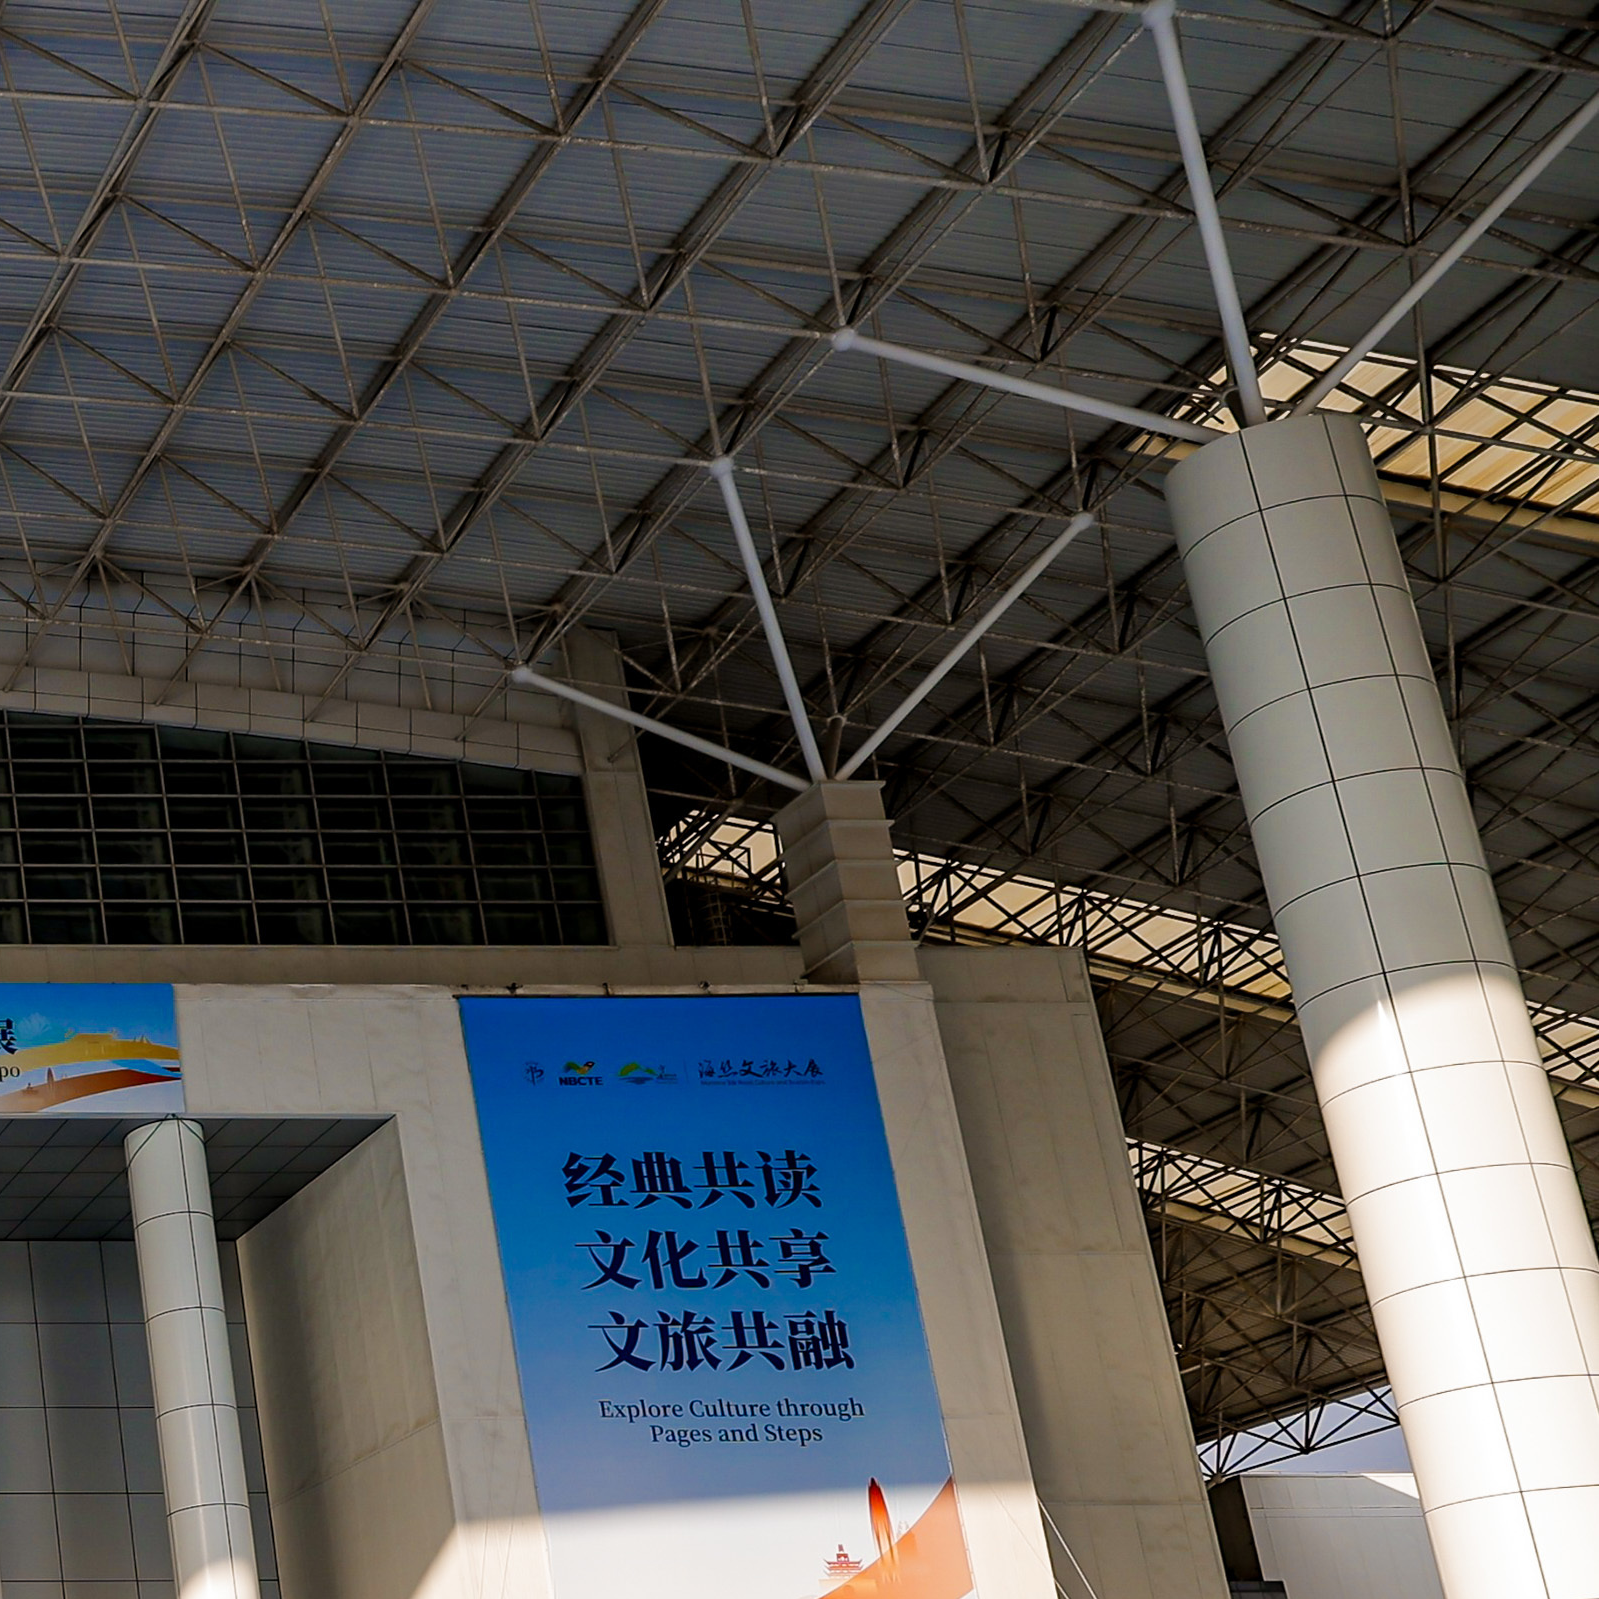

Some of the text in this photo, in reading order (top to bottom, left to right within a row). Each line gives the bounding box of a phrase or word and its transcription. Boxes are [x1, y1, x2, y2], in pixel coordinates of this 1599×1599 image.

[559, 1076, 603, 1086] NBCTE
[561, 1149, 824, 1210] 经典共读
[574, 1228, 837, 1291] 文化共享
[587, 1309, 856, 1373] 文旅共融
[599, 1398, 865, 1423] Explore Culture through
[650, 1424, 823, 1448] Pages and Steps
